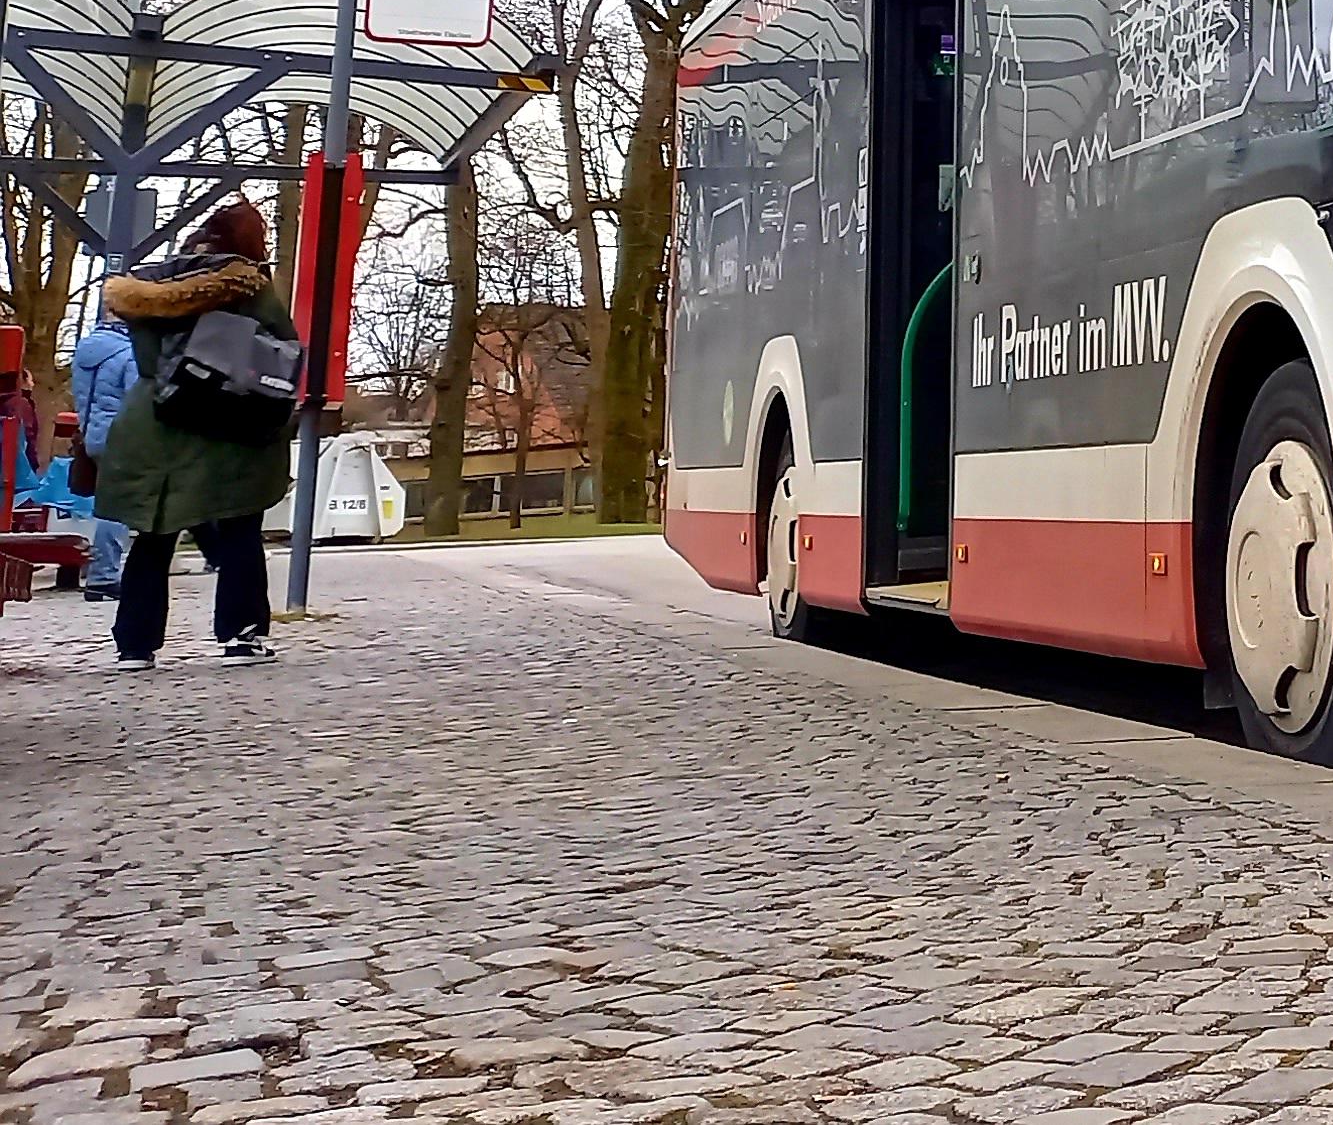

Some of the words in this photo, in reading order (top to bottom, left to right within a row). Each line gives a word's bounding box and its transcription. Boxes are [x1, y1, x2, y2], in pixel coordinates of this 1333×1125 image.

[972, 311, 995, 388] Ihr
[1000, 304, 1072, 383] Partner
[1079, 303, 1106, 373] im
[1112, 275, 1171, 367] MVV.
